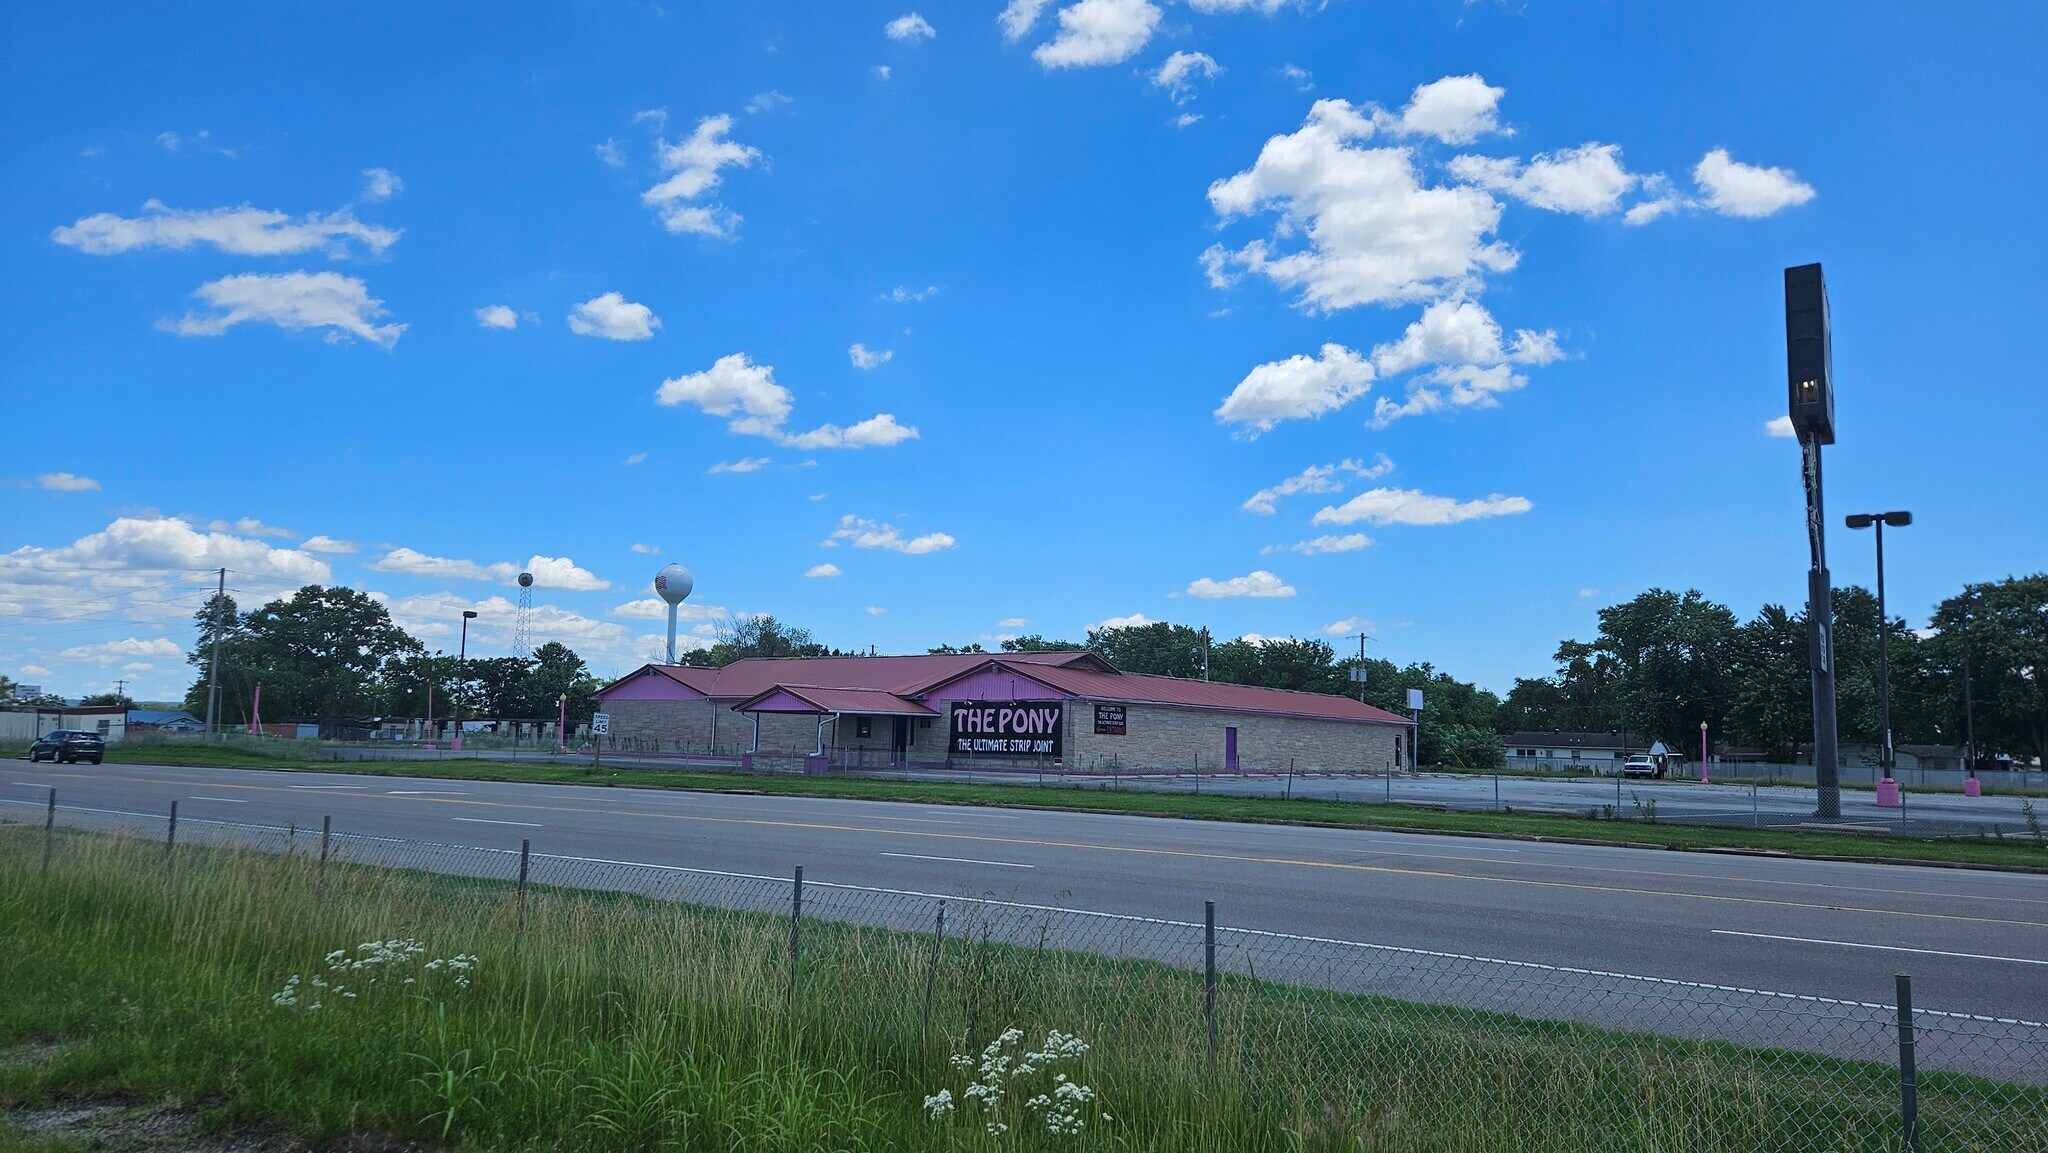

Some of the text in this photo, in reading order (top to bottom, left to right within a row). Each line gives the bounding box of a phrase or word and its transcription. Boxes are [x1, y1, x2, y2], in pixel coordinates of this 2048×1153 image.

[954, 708, 1060, 734] THE PONY
[1098, 711, 1124, 720] THE PONY
[957, 738, 1054, 753] THE ULTIMATE STRIP JOINT
